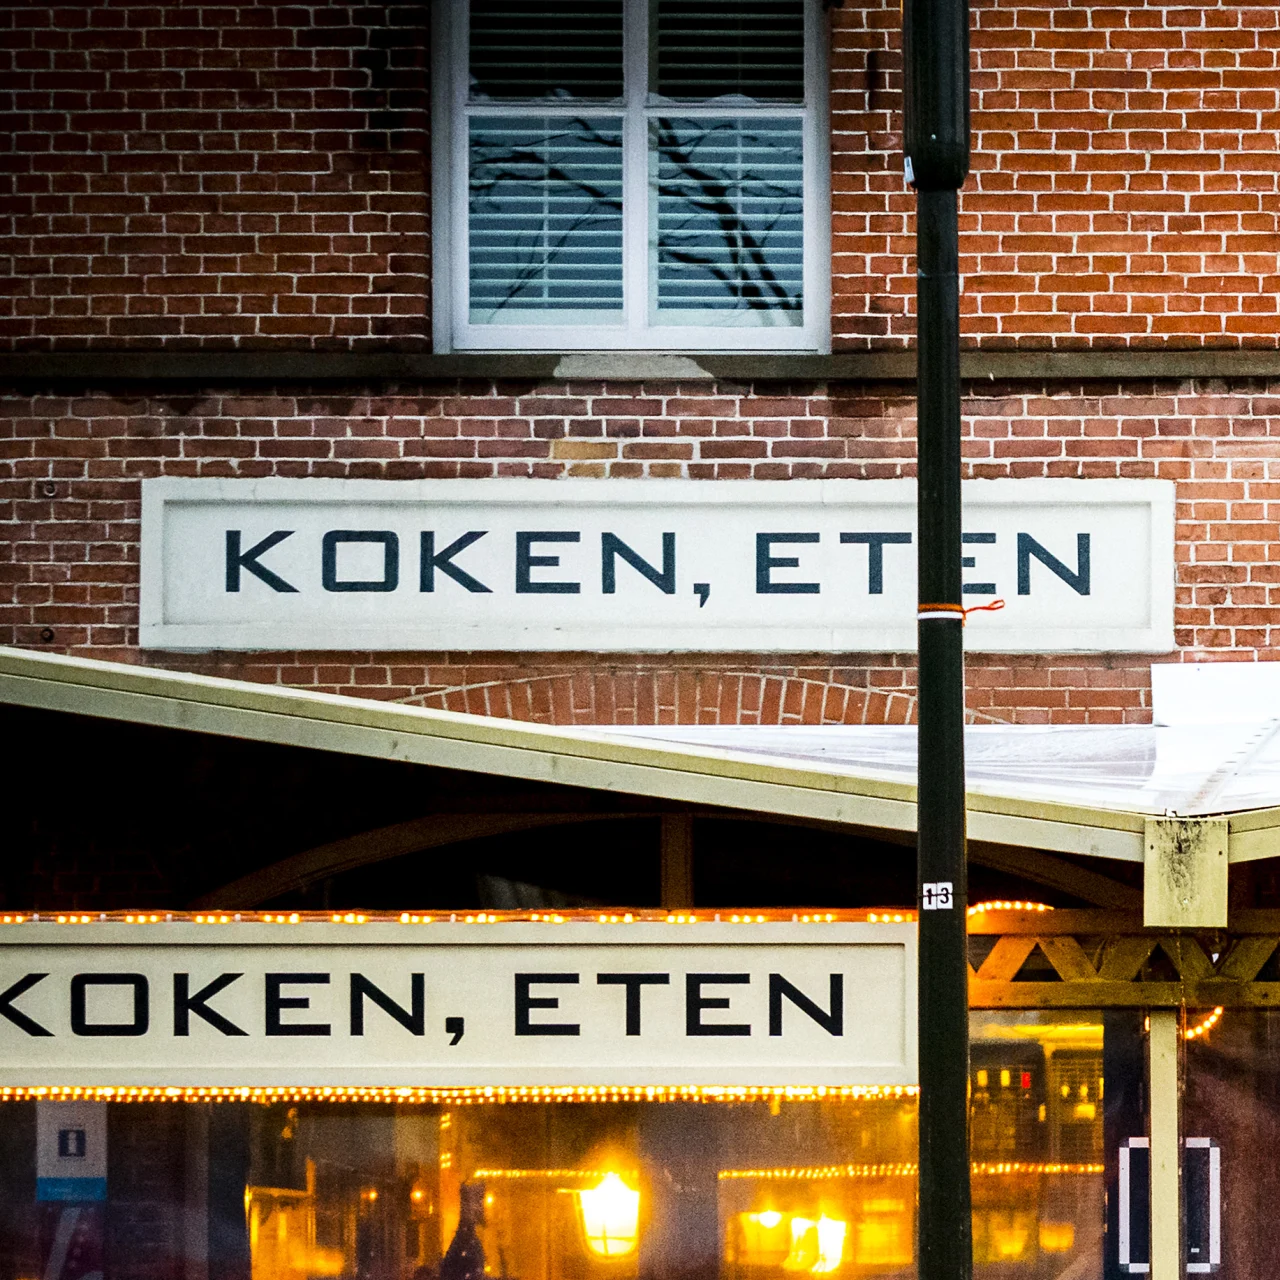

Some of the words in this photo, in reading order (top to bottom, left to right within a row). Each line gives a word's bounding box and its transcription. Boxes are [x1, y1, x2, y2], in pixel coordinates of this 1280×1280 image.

[226, 529, 710, 608] KOKEN,
[756, 531, 1091, 596] ETEN
[926, 888, 949, 904] 13
[0, 972, 466, 1046] KOKEN,
[514, 972, 845, 1037] ETEN
